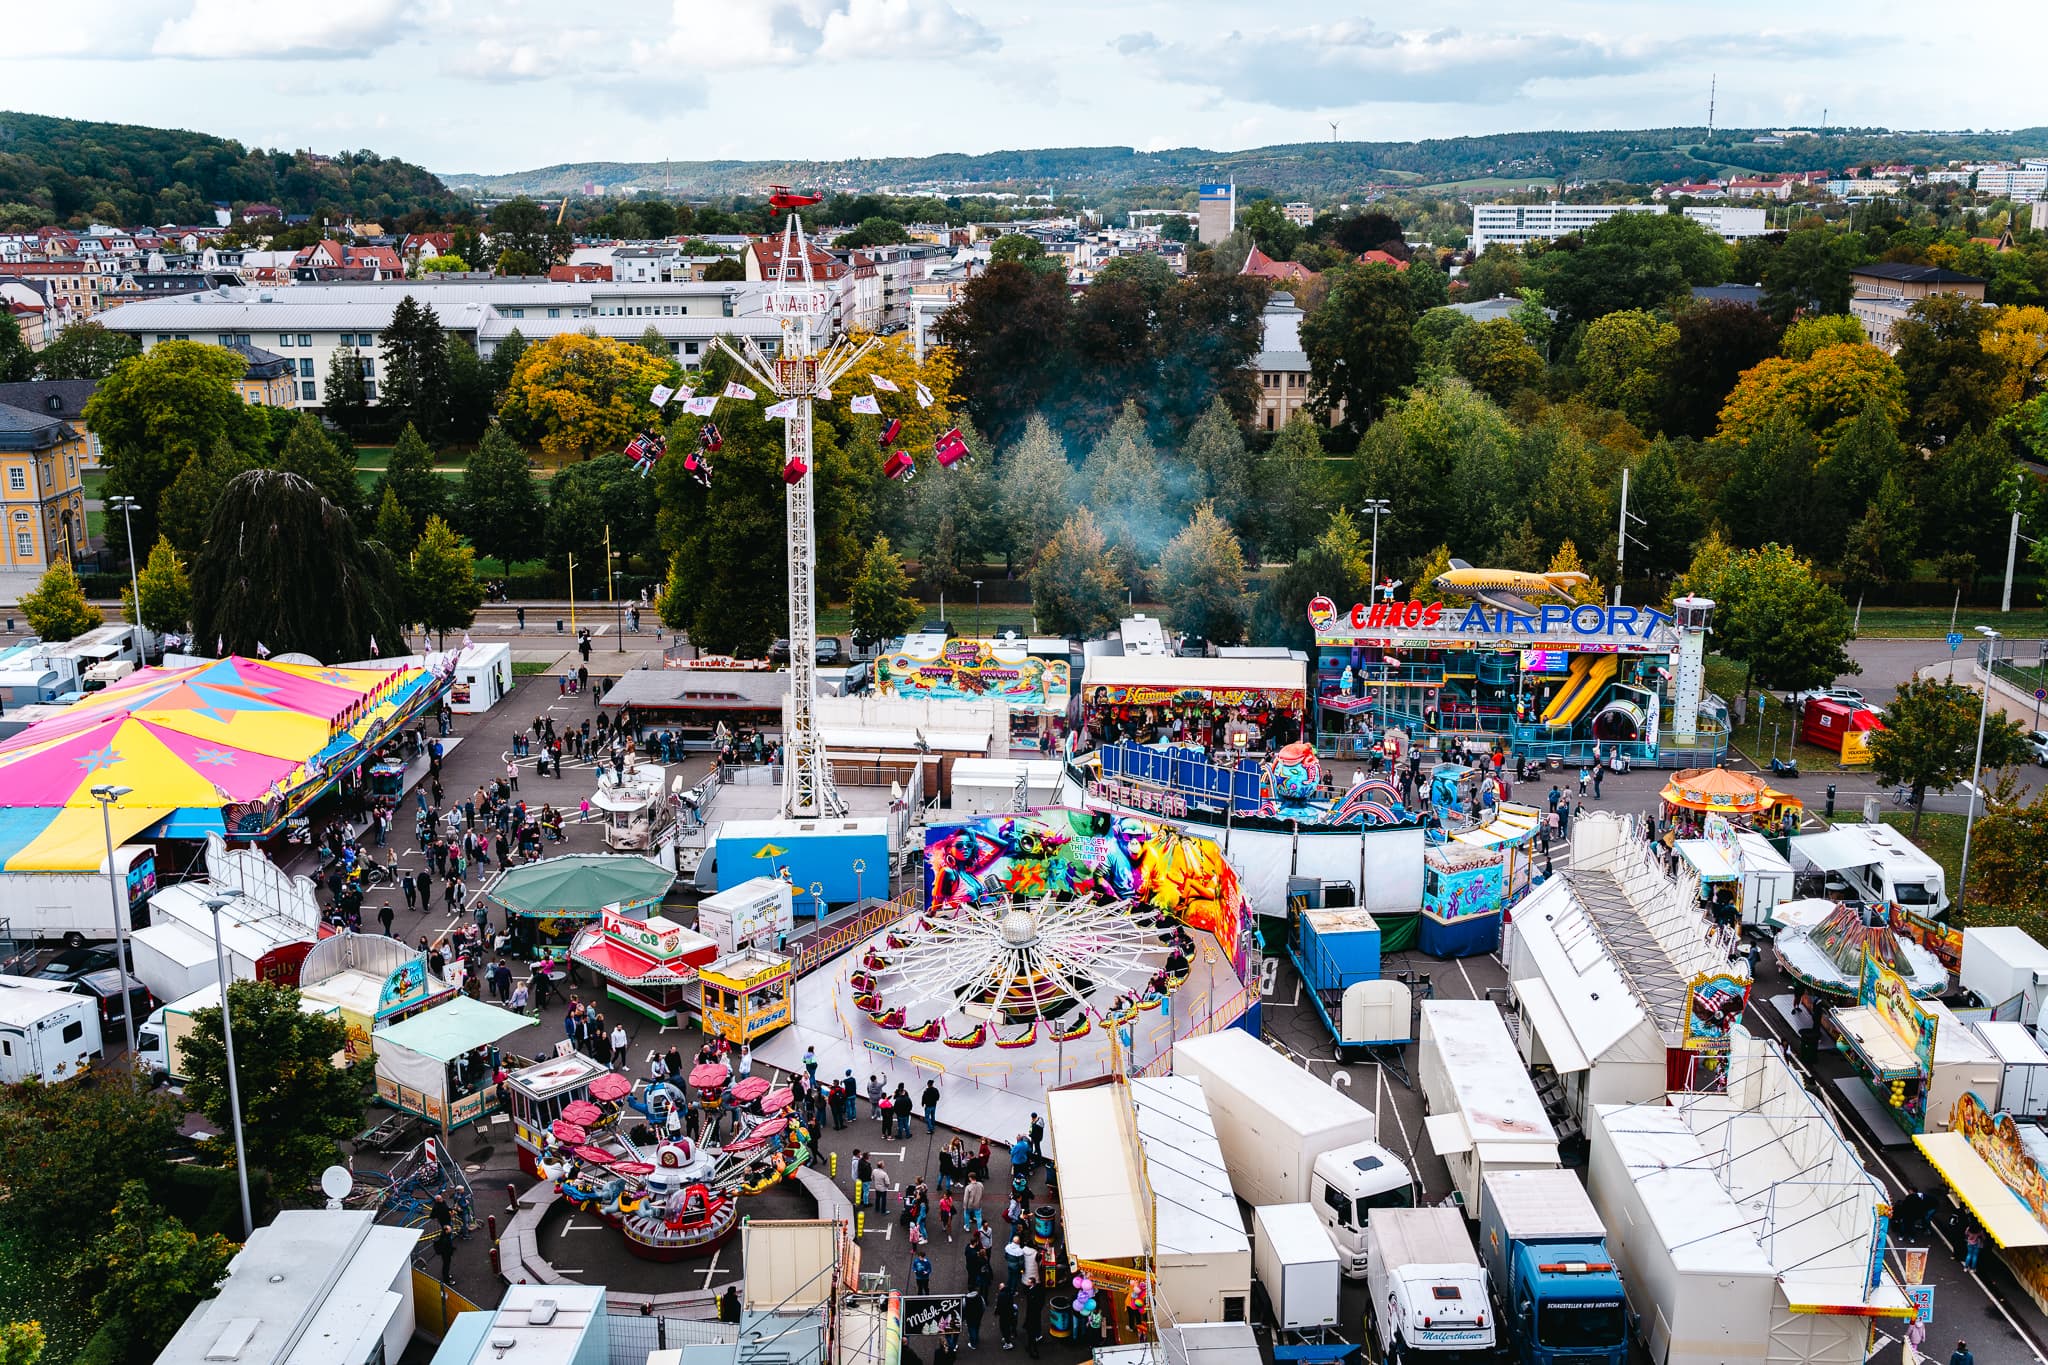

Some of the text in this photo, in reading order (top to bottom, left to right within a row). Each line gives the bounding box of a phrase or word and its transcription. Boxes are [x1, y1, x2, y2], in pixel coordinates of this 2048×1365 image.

[1350, 599, 1444, 630] CHAOS
[1458, 603, 1673, 639] AIRPORT
[1087, 781, 1187, 817] SUPERSTAR
[1071, 843, 1108, 853] THE PARTY
[1091, 836, 1105, 845] GET
[1074, 852, 1106, 862] STARTED
[745, 966, 787, 988] SUPER STAR
[747, 1007, 787, 1032] Kasse
[906, 1299, 960, 1327] Milch-Eis
